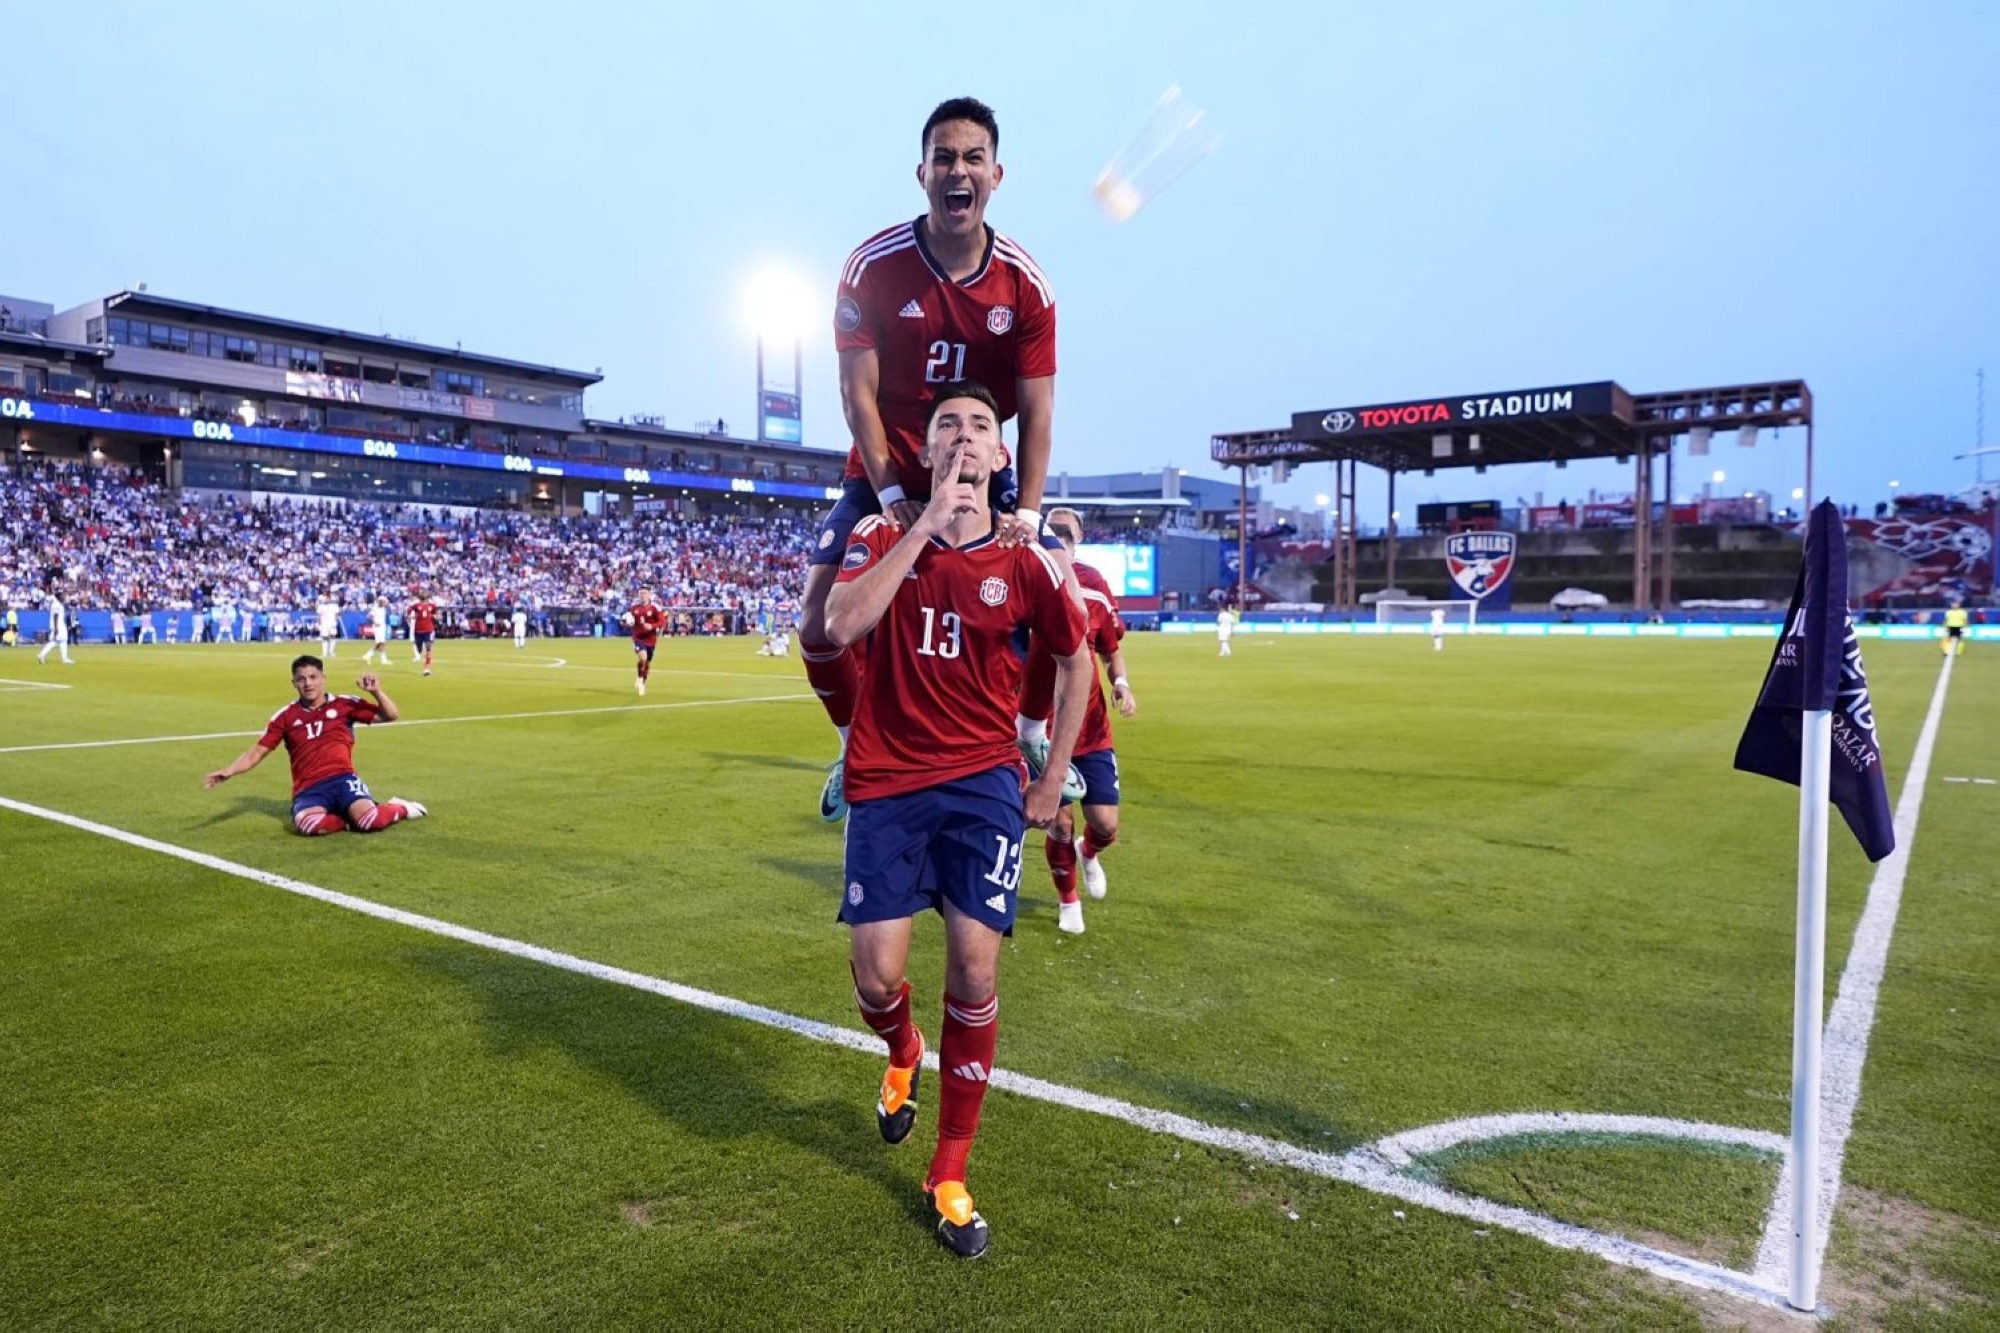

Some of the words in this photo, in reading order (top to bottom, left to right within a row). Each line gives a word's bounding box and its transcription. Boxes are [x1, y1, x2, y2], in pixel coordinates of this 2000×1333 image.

[926, 340, 966, 383] 21
[1360, 404, 1449, 428] TOYOTA
[1462, 391, 1572, 420] STADIUM
[917, 607, 961, 659] 13
[305, 720, 324, 739] 17
[1831, 713, 1876, 767] QATAR
[984, 835, 1020, 890] 13
